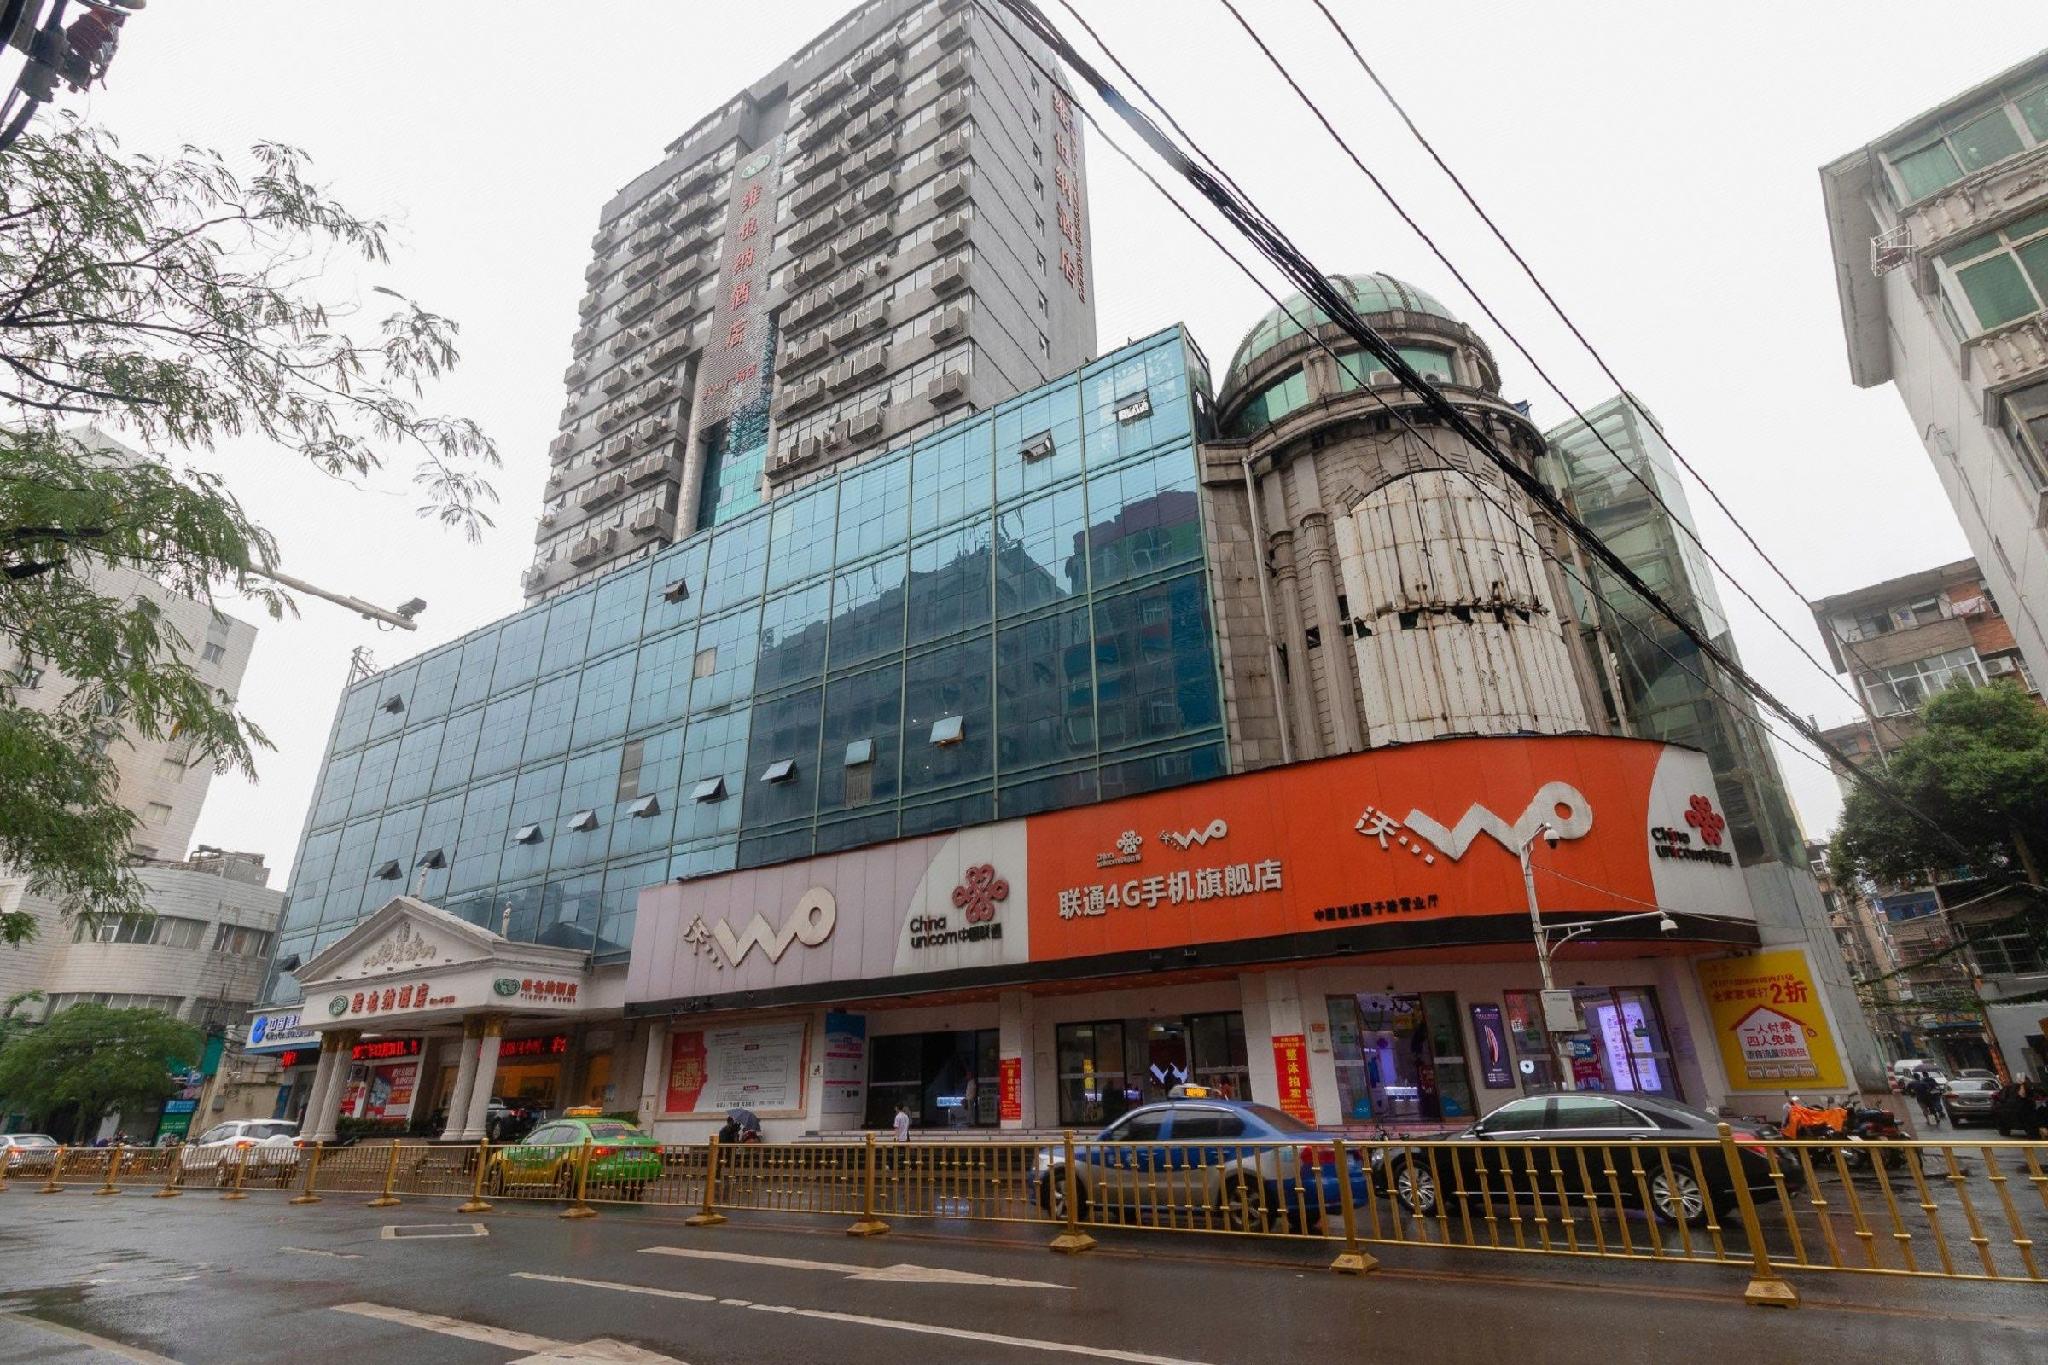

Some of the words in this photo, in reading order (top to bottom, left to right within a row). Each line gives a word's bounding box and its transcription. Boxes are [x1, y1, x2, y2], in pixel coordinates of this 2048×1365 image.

[1355, 806, 1400, 849] 沃
[1057, 858, 1282, 920] 联通4G手机旗舰店
[910, 915, 946, 933] China
[911, 930, 957, 949] unicom
